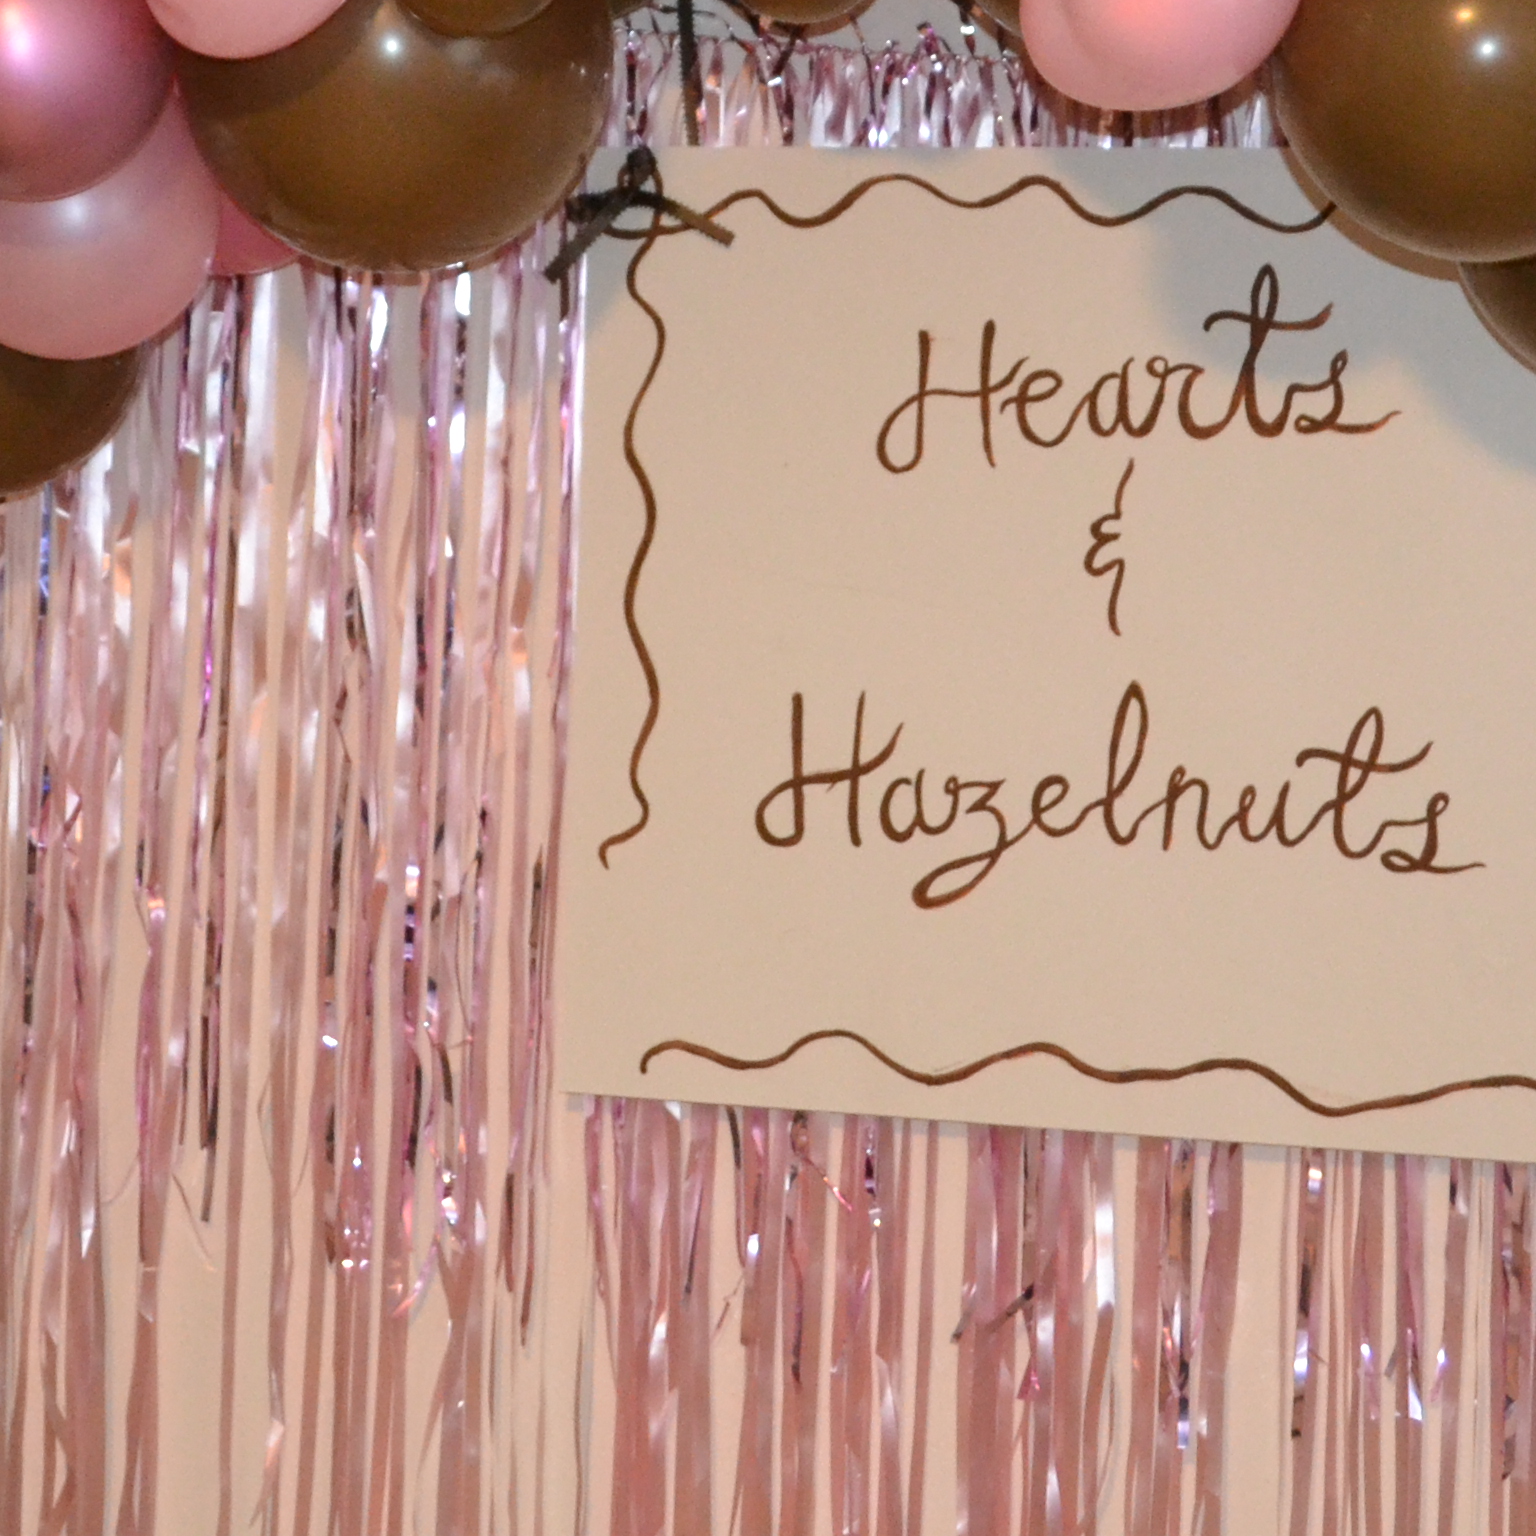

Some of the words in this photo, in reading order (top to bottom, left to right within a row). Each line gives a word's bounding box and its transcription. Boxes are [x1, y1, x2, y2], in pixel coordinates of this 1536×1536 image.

[875, 263, 1403, 474] Hearts
[1083, 458, 1135, 637] &
[754, 680, 1488, 910] Hazelnuts
